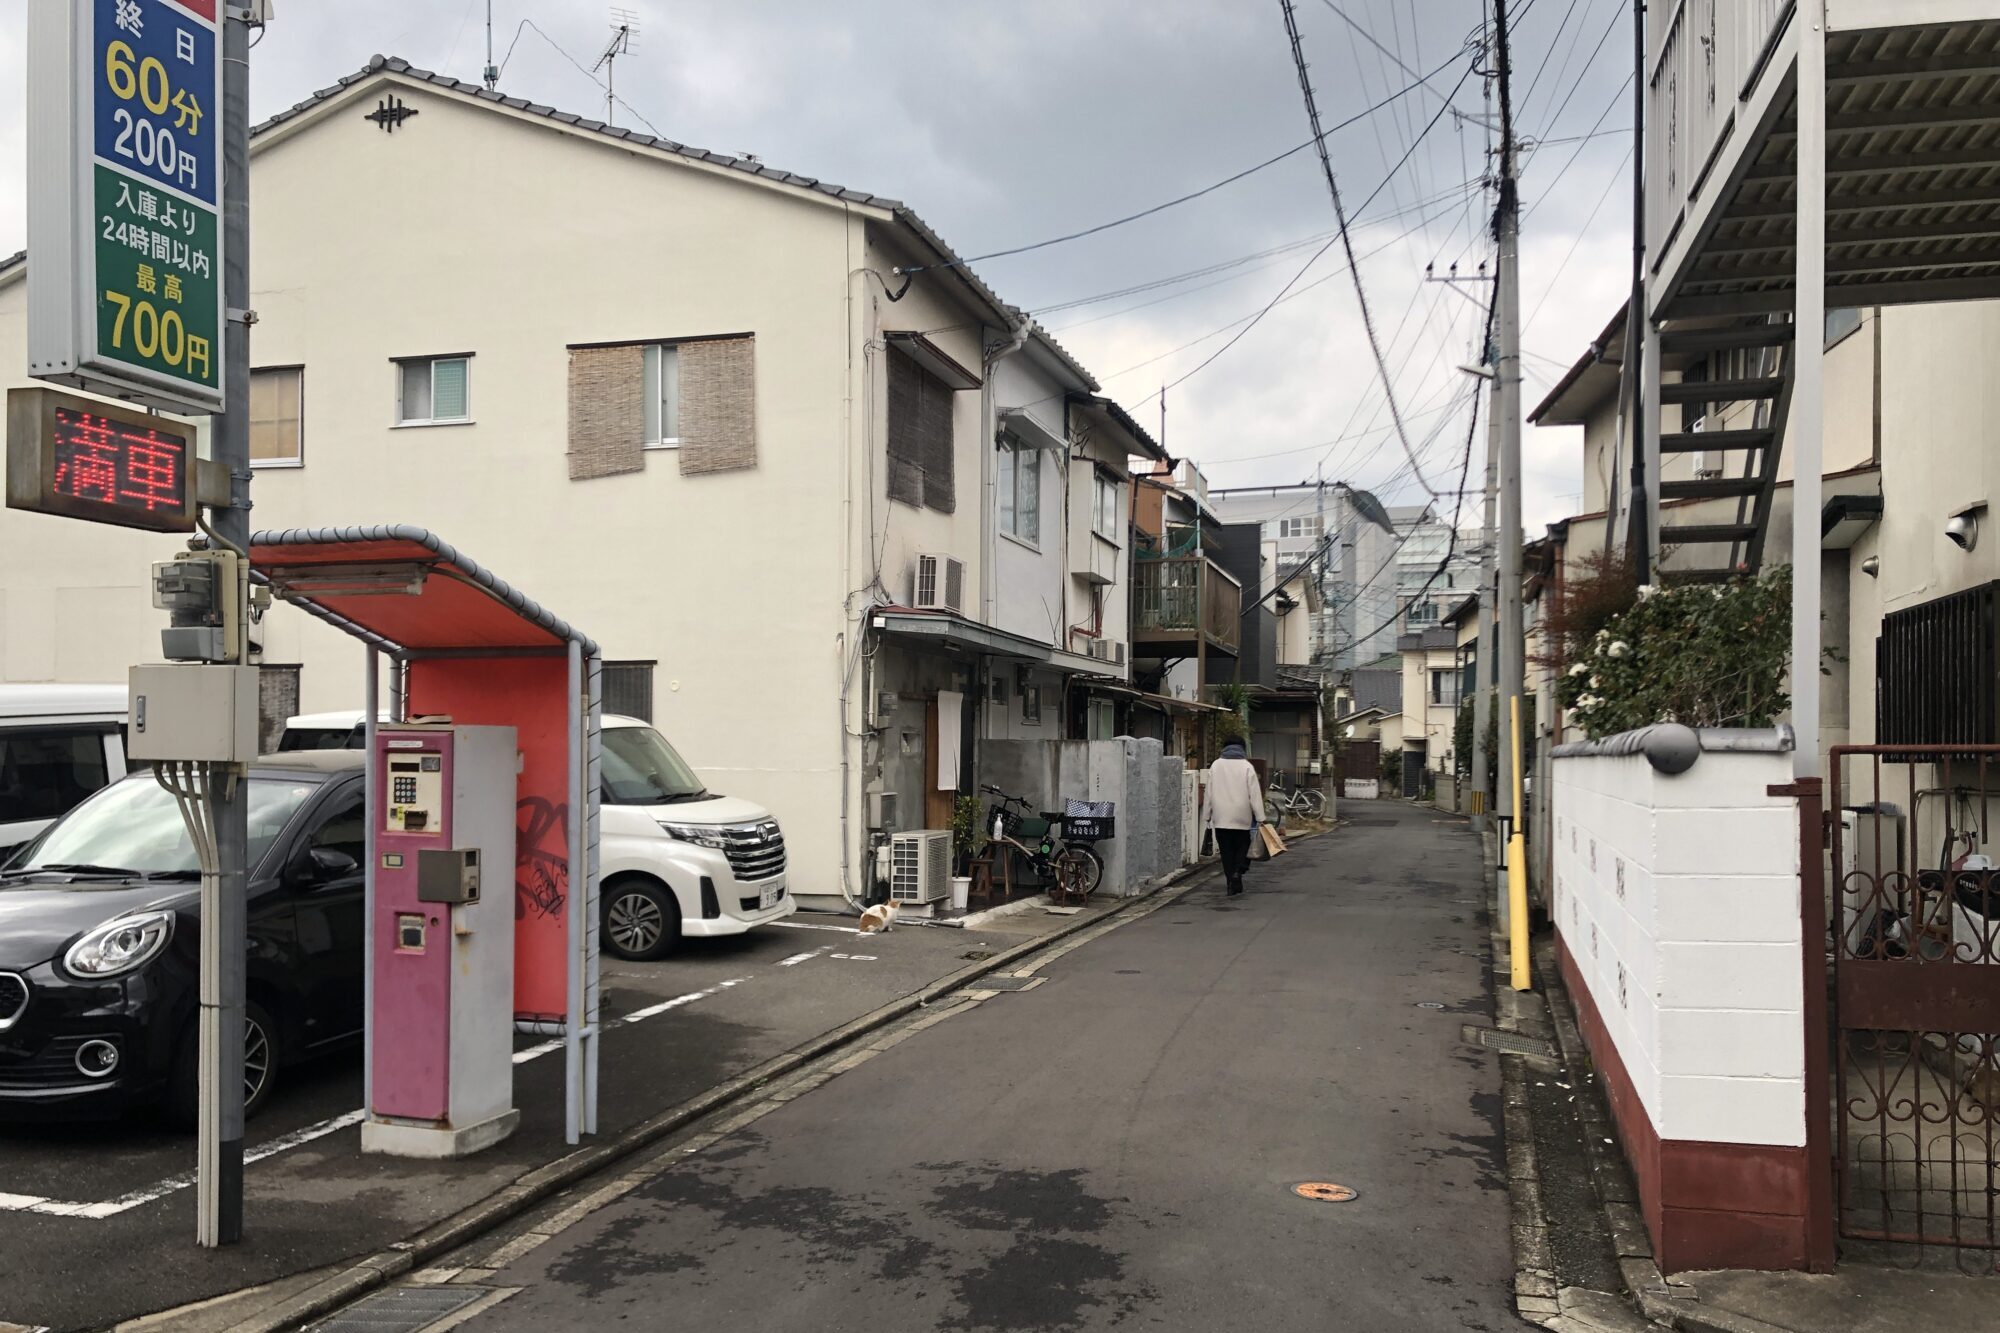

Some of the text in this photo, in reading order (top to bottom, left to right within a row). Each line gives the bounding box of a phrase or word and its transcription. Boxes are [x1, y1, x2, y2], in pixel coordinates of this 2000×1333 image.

[115, 0, 195, 65] 終日
[106, 40, 203, 136] 60分
[113, 108, 196, 189] 200円
[115, 181, 195, 236] 入庫より
[102, 215, 209, 279] 24時間以内
[136, 263, 182, 304] 最高
[106, 290, 209, 379] 700円
[54, 411, 182, 511] 満車
